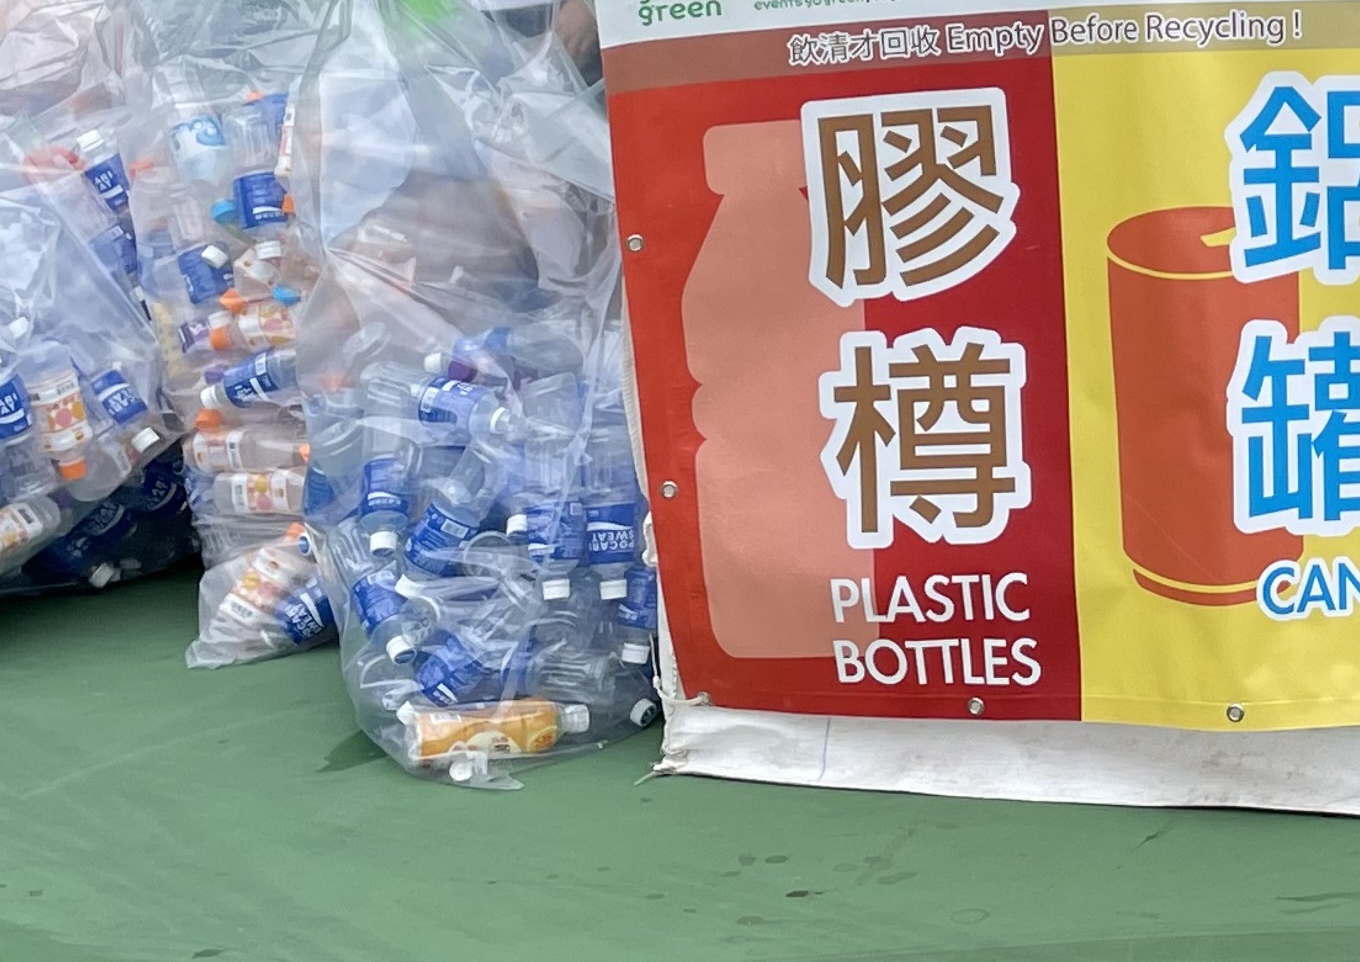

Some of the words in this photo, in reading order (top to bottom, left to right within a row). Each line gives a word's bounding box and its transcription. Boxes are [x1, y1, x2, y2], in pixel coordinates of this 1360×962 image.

[787, 26, 939, 66] 飲清才回收
[946, 22, 1043, 59] Empty
[1050, 11, 1138, 46] Before
[1145, 9, 1286, 45] Recycling
[810, 96, 1024, 540] 膠樽
[830, 571, 1031, 624] PLASTIC
[832, 637, 1042, 686] BOTTLES
